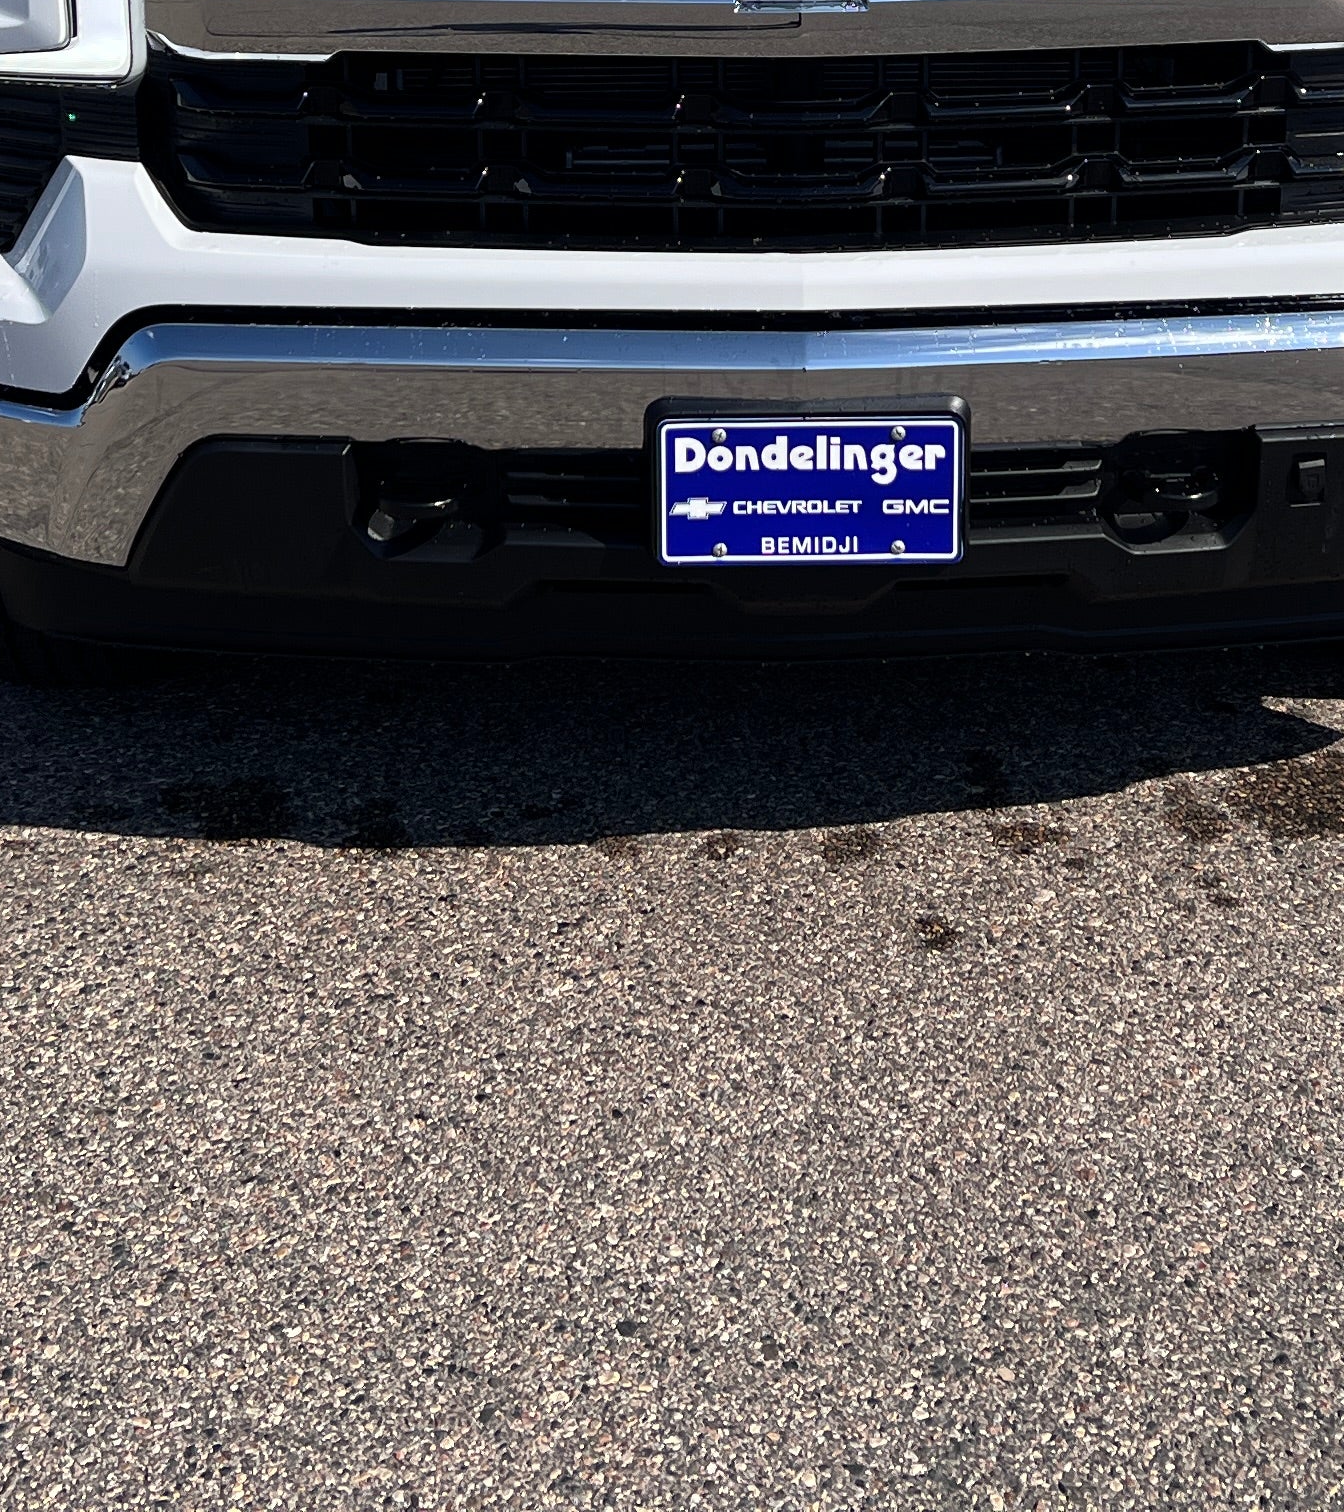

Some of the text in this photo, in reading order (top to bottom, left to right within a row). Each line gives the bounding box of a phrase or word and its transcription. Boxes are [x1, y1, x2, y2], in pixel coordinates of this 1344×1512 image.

[674, 435, 946, 486] Dondelinger
[732, 498, 950, 515] CHEVROLET GMC
[760, 536, 859, 555] BEMIDJI
